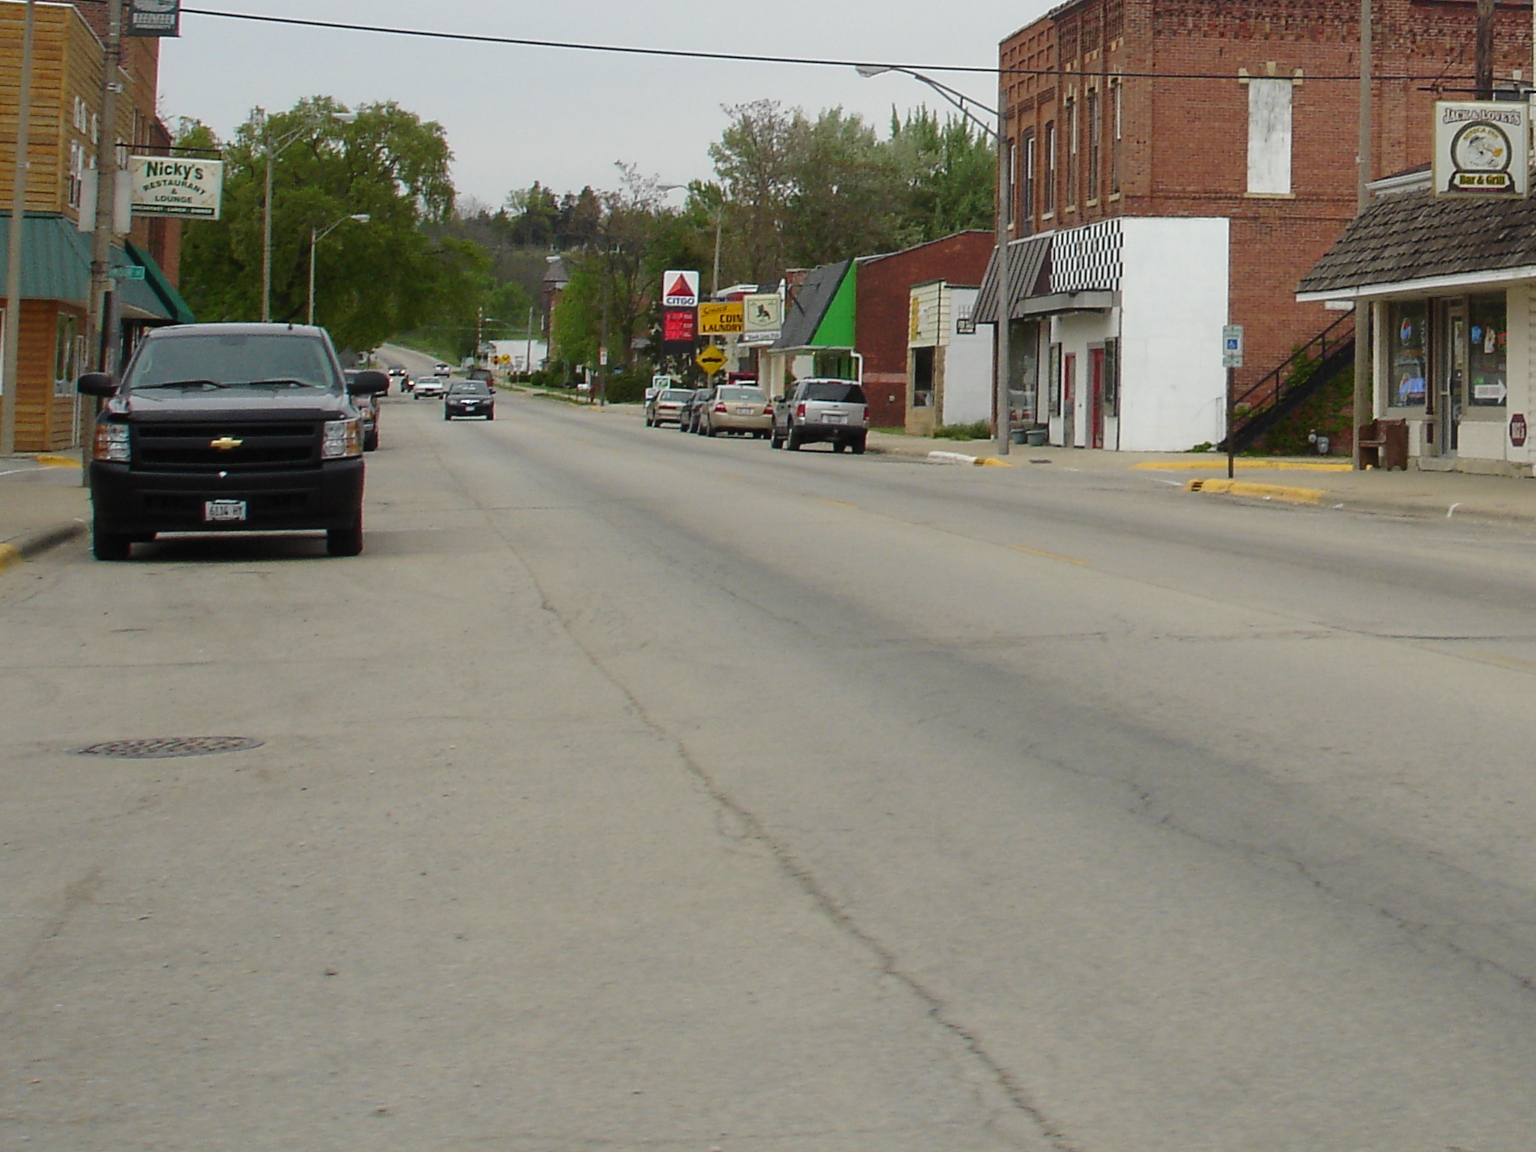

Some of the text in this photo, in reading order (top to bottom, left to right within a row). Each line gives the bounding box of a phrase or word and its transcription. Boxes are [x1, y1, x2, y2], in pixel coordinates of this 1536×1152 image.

[1443, 108, 1471, 124] JACK
[146, 161, 203, 180] Nicky's
[1460, 175, 1506, 186] Bar & Grill
[143, 179, 206, 195] RESTAURANT
[155, 195, 192, 203] LOUNGE
[720, 314, 743, 323] COIN
[703, 324, 742, 332] LAUNDRY
